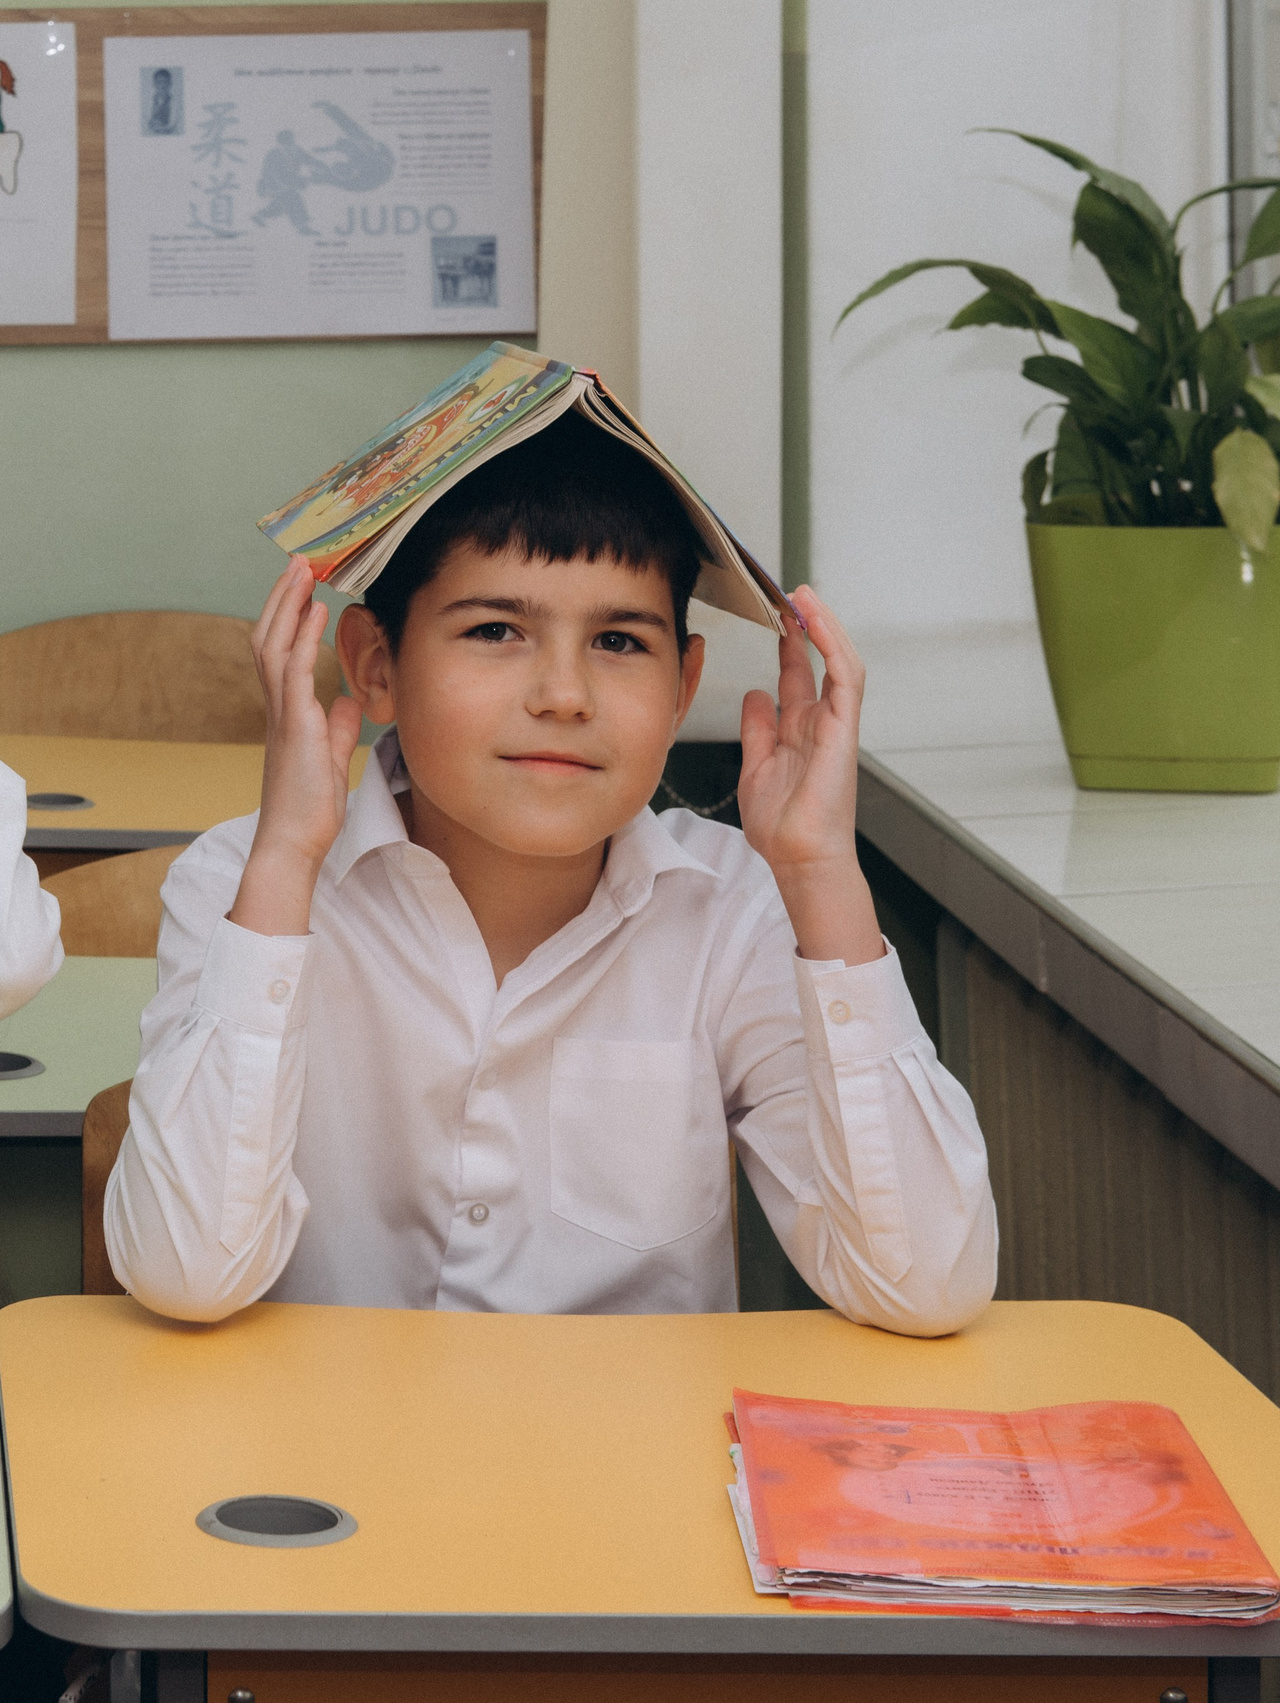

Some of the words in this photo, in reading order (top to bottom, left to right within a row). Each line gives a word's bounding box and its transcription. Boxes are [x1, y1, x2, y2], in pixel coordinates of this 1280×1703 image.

[333, 203, 459, 236] JUDO
[481, 390, 508, 411] 4
[328, 385, 538, 552] Мистецтво
